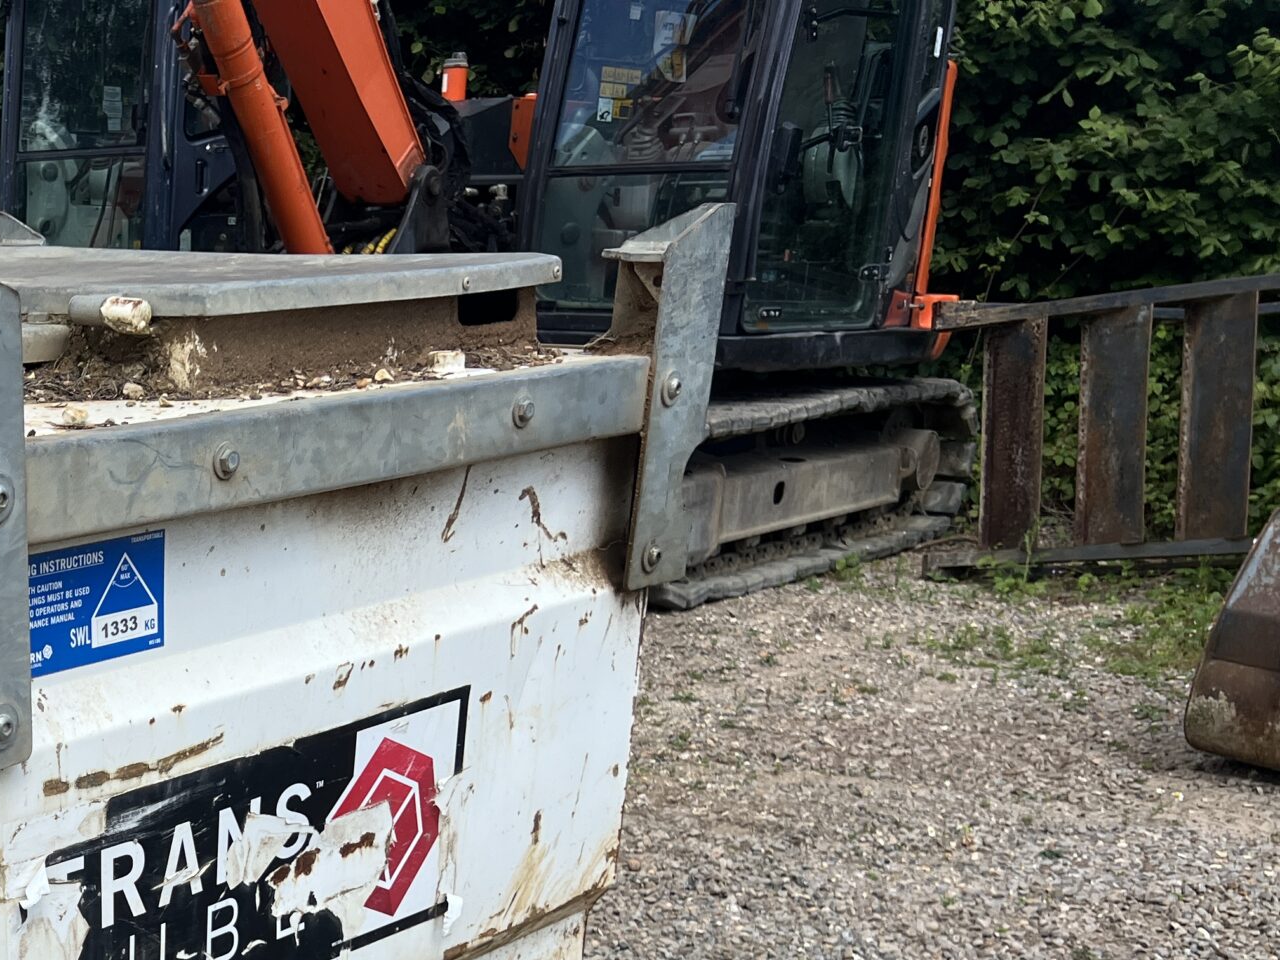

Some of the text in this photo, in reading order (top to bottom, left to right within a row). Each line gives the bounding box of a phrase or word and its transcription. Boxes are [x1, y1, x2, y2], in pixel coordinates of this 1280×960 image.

[40, 551, 104, 574] INSTRUCTIONS
[29, 586, 90, 606] LINGS MUST BE USED
[37, 581, 63, 593] CAUTION
[35, 602, 69, 616] OPERATORS
[70, 599, 83, 609] AND
[29, 612, 75, 630] NANCE MANUAL
[101, 615, 156, 639] 1333 KG
[70, 625, 91, 648] SWL
